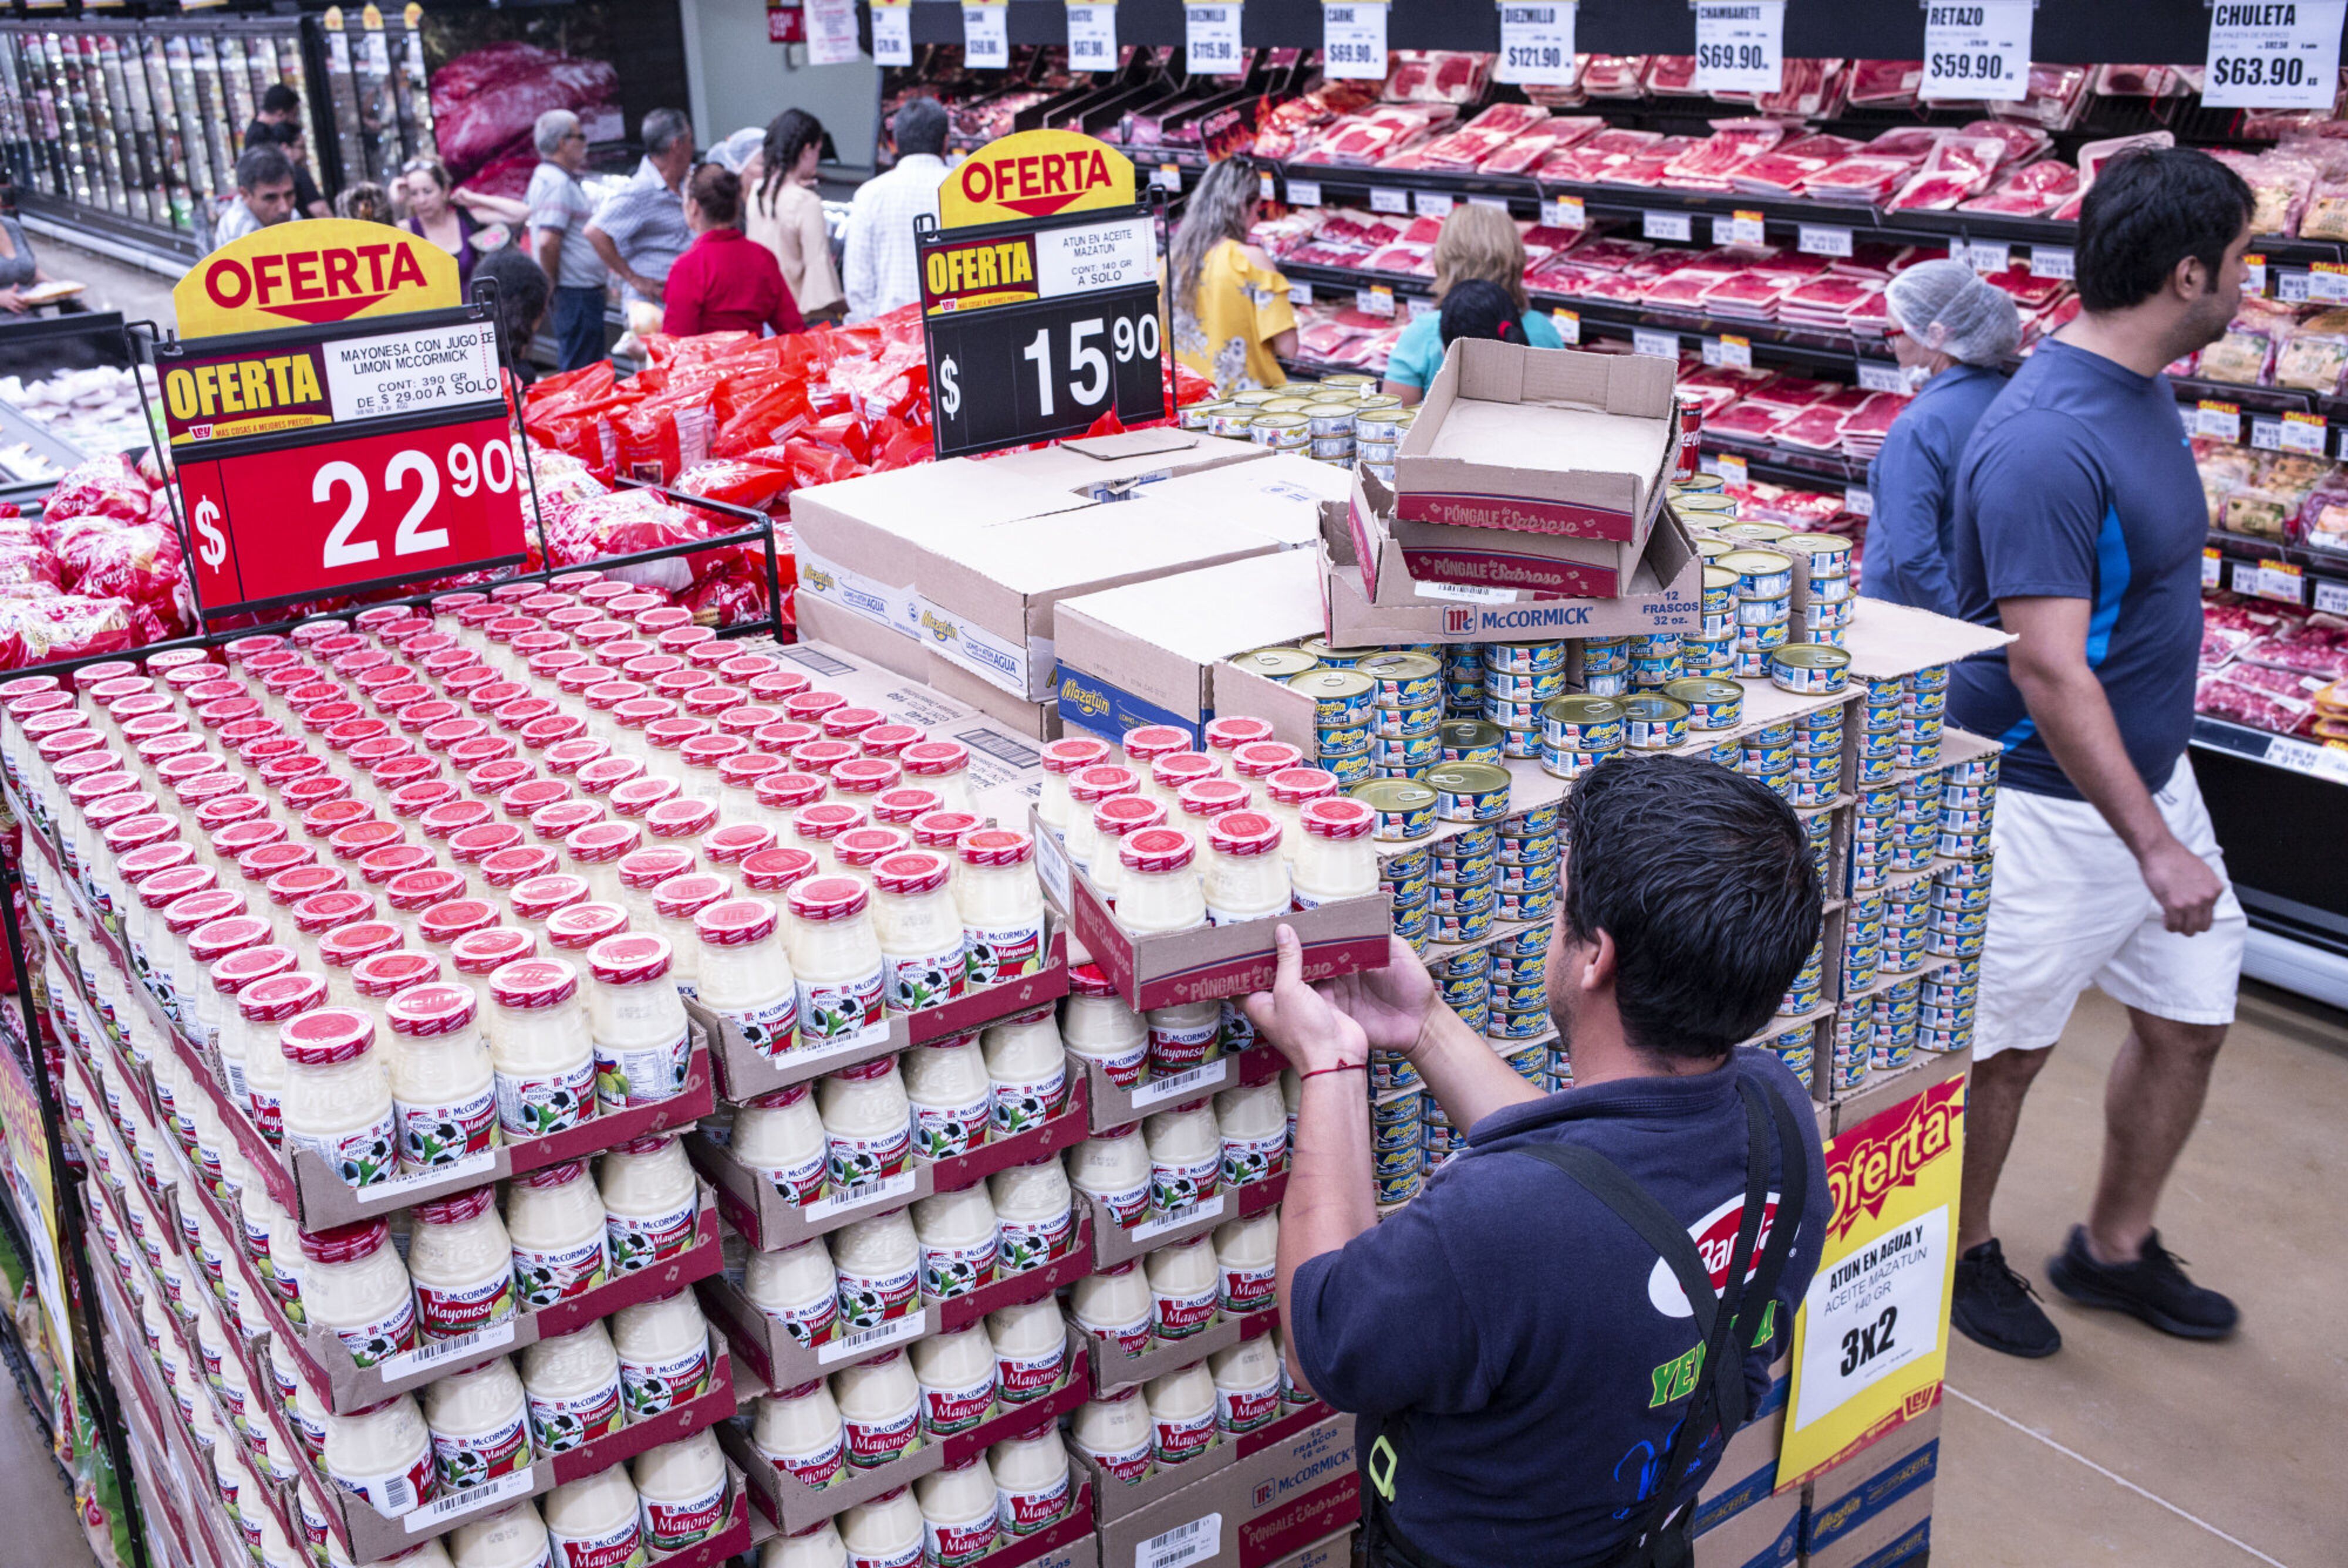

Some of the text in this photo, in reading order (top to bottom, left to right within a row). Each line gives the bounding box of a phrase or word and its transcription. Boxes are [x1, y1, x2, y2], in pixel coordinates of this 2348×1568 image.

[1328, 8, 1355, 23] CARNE
[1505, 8, 1556, 24] DIEZMILLO
[1701, 7, 1760, 19] CHAMBARETE
[1931, 8, 1983, 26] RETAZO
[2216, 5, 2295, 26] CHULETA
[1508, 47, 1560, 67] $121.90
[1699, 44, 1761, 69] $69.90
[1932, 53, 2001, 79] $59.90
[2214, 56, 2303, 86] $63.90
[962, 149, 1112, 202] OFERTA
[1063, 229, 1132, 248] ATUN EN ACEITE
[1074, 244, 1115, 257] MAZATUN
[205, 242, 428, 309] OFERTA
[927, 241, 1034, 295] OFERTA
[1071, 259, 1132, 276] CONT: 140 GR
[1078, 271, 1122, 286] A SOLO
[341, 332, 495, 362] MAYONESA CON JUGO DE
[353, 349, 468, 375] LIMON MCCORMICK
[165, 353, 322, 420] OFERTA
[357, 377, 498, 408] DE $ 29.00 A SOLO
[377, 372, 468, 393] CONT: 390 GR
[939, 354, 961, 421] $
[231, 427, 252, 435] COSAS
[259, 421, 286, 432] MEJORES
[288, 417, 314, 427] PRECIOS
[1443, 503, 1579, 533] PÓNGALE Sabroso
[195, 495, 226, 573] $
[804, 563, 835, 589] Mazatún
[1433, 557, 1564, 585] PÓNGALE Sabroso
[866, 597, 885, 614] AGUA
[1643, 601, 1699, 614] FRASCOS
[1664, 591, 1678, 601] 12
[922, 610, 958, 640] Mazatún
[1482, 607, 1590, 630] McCORMICK
[1654, 615, 1688, 626] 32 oz.
[994, 653, 1017, 674] AGUA
[1061, 678, 1110, 715] Mazatún
[988, 927, 1031, 941] McCORMICK
[997, 944, 1035, 959] Mayonesa
[1190, 974, 1251, 999] PÓNGALE
[1172, 1029, 1213, 1043] McCORMICK
[1151, 1042, 1206, 1065] Mayonesa
[453, 1094, 493, 1116] McCORMICK
[643, 1209, 686, 1229] McCORMICK
[549, 1243, 595, 1263] McCORMICK
[1830, 1225, 1923, 1293] ATUN EN AGUA Y
[875, 1270, 915, 1287] McCORMICK
[1824, 1246, 1928, 1316] ACEITE MAZATUN
[450, 1280, 500, 1302] McCORMICK
[1855, 1280, 1891, 1314] 140 GR
[427, 1302, 492, 1324] Mayonesa
[659, 1351, 700, 1374] McCORMICK
[1008, 1362, 1064, 1390] Mayonesa
[570, 1385, 613, 1410] McCORMICK
[937, 1392, 994, 1420] Mayonesa
[473, 1422, 517, 1447] McCORMICK
[874, 1414, 915, 1434] McCORMICK
[1310, 1428, 1321, 1438] 12
[855, 1425, 916, 1454] Mayonesa
[1293, 1429, 1338, 1457] FRASCOS
[801, 1445, 841, 1467] McCORMICK
[1900, 1452, 1932, 1483] ACEITE
[1278, 1448, 1350, 1494] McCORMICK
[678, 1492, 721, 1514] McCORMICK
[658, 1503, 723, 1539] Mayonesa
[1249, 1513, 1295, 1547] PÓNGALE
[575, 1534, 639, 1567] Mayonesa
